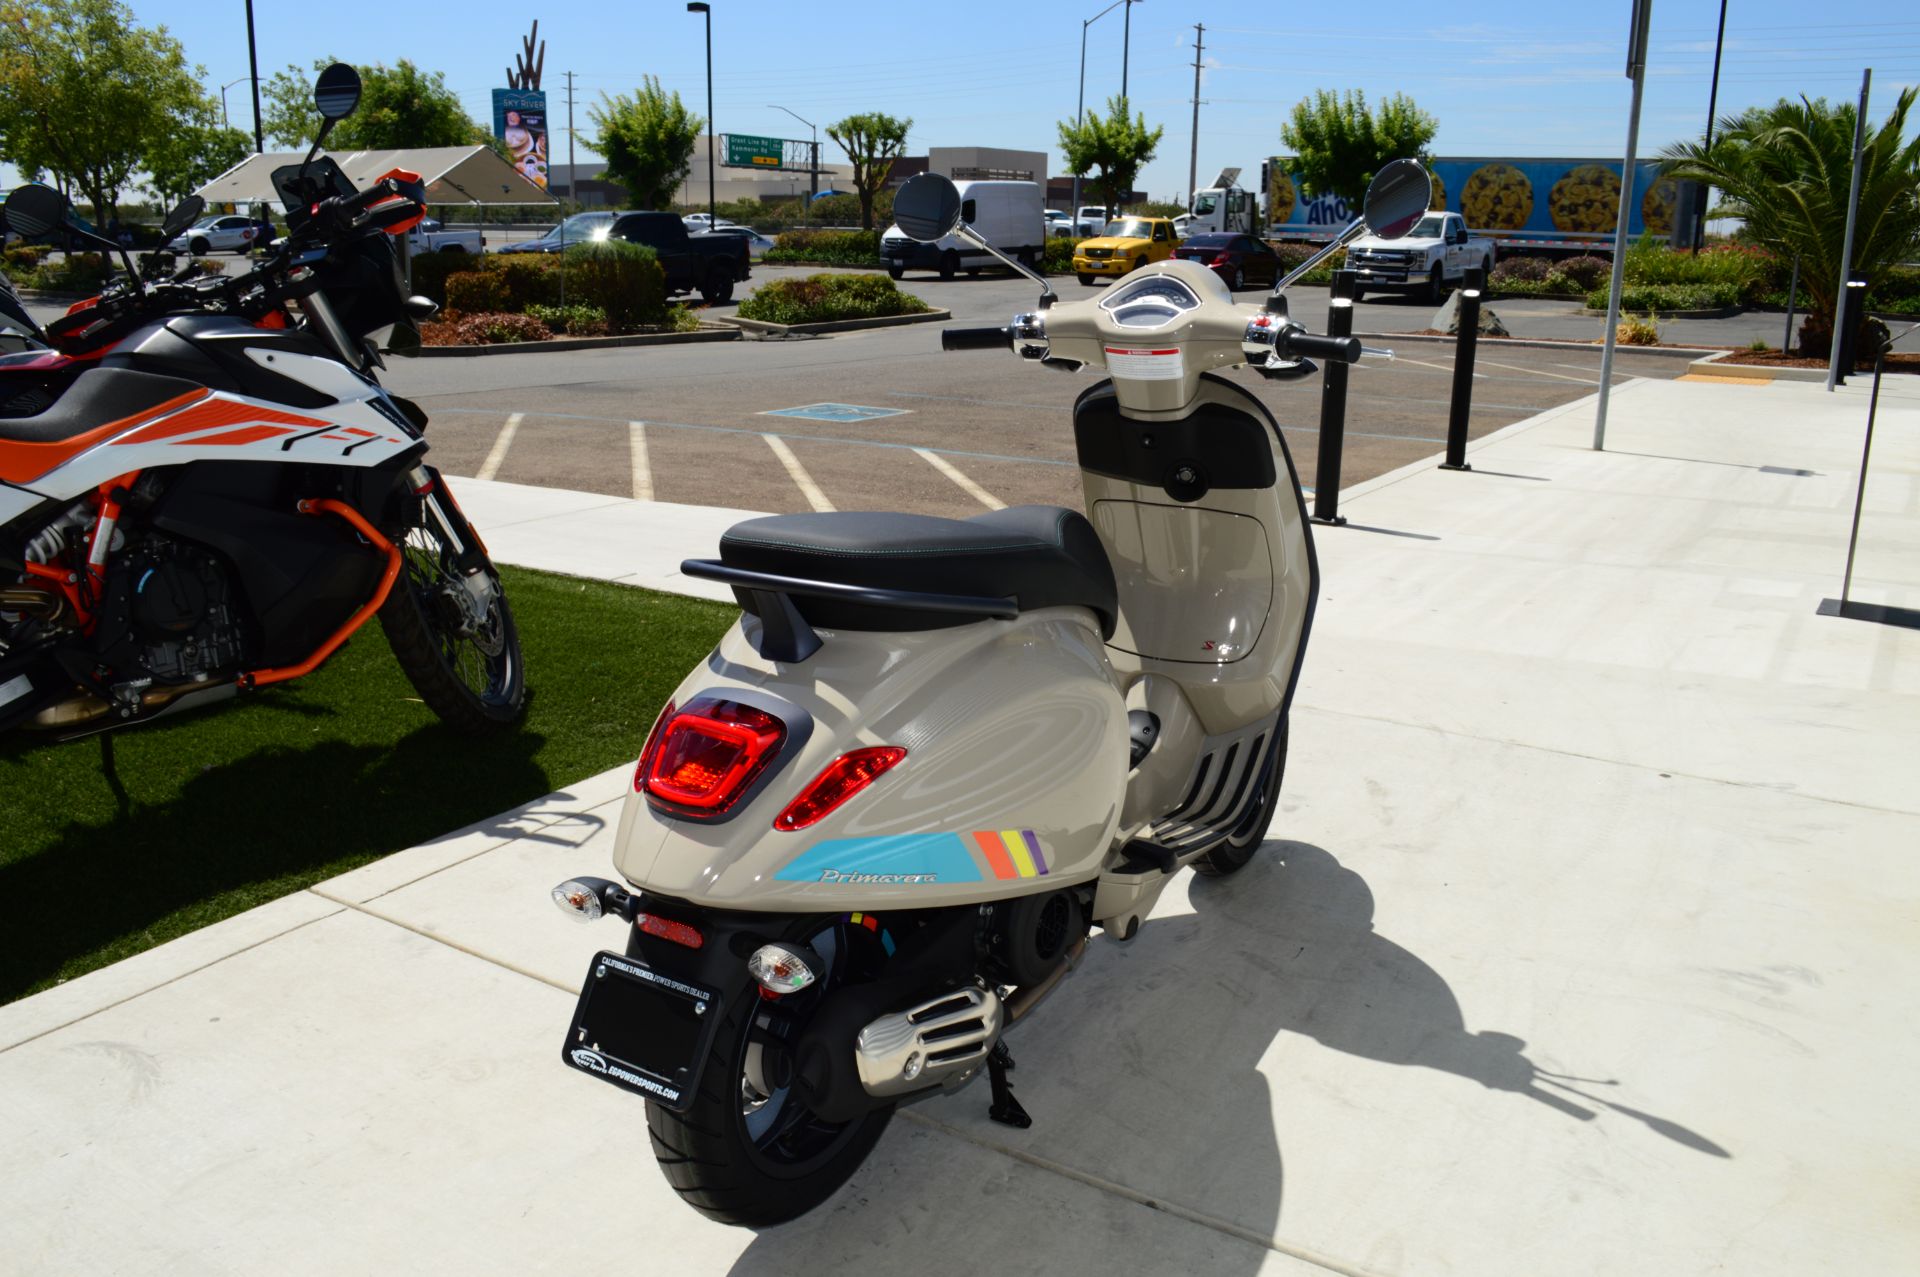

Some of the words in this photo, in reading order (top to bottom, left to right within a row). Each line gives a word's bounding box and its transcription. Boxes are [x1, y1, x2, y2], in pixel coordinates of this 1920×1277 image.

[503, 99, 519, 107] SKY
[521, 100, 545, 109] RIVER
[819, 868, 938, 883] Primavera
[602, 957, 633, 973] CALIFORNIA'S
[654, 975, 671, 988] POWER
[671, 982, 690, 993] SPORTS
[690, 987, 709, 1000] DEALER
[608, 1065, 679, 1100] EGPOWERSPORTS.COM
